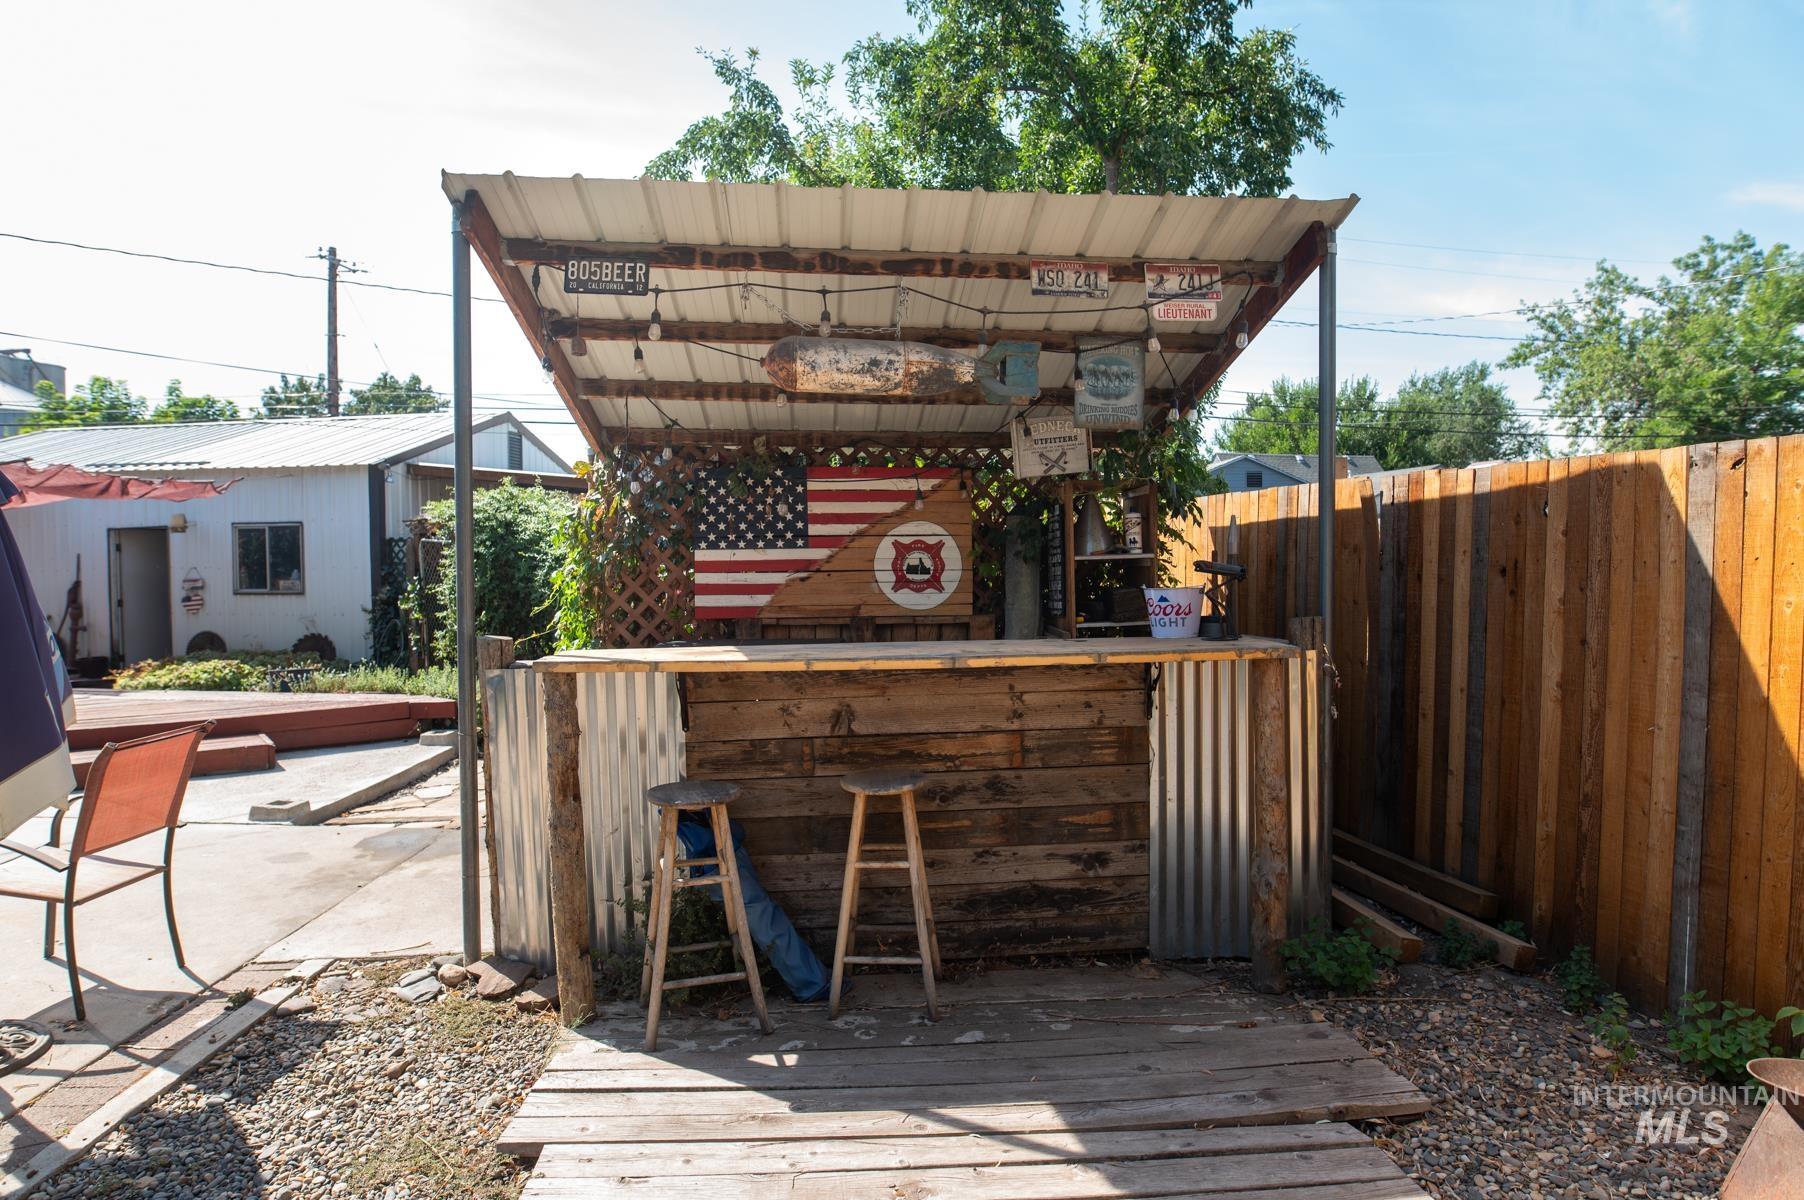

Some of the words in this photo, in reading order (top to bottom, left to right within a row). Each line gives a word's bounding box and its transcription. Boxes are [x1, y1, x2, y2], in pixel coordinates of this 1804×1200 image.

[568, 260, 646, 282] 805BEER
[1057, 262, 1084, 270] IDAHO
[569, 281, 577, 289] 20
[588, 281, 624, 290] CALIFORNIA
[636, 283, 643, 291] 12
[1074, 270, 1098, 289] 241
[1158, 308, 1213, 319] LIEUTENANT
[1022, 420, 1080, 437] EDNEC
[1029, 434, 1079, 446] UTFITTERS
[1147, 597, 1192, 616] Coors
